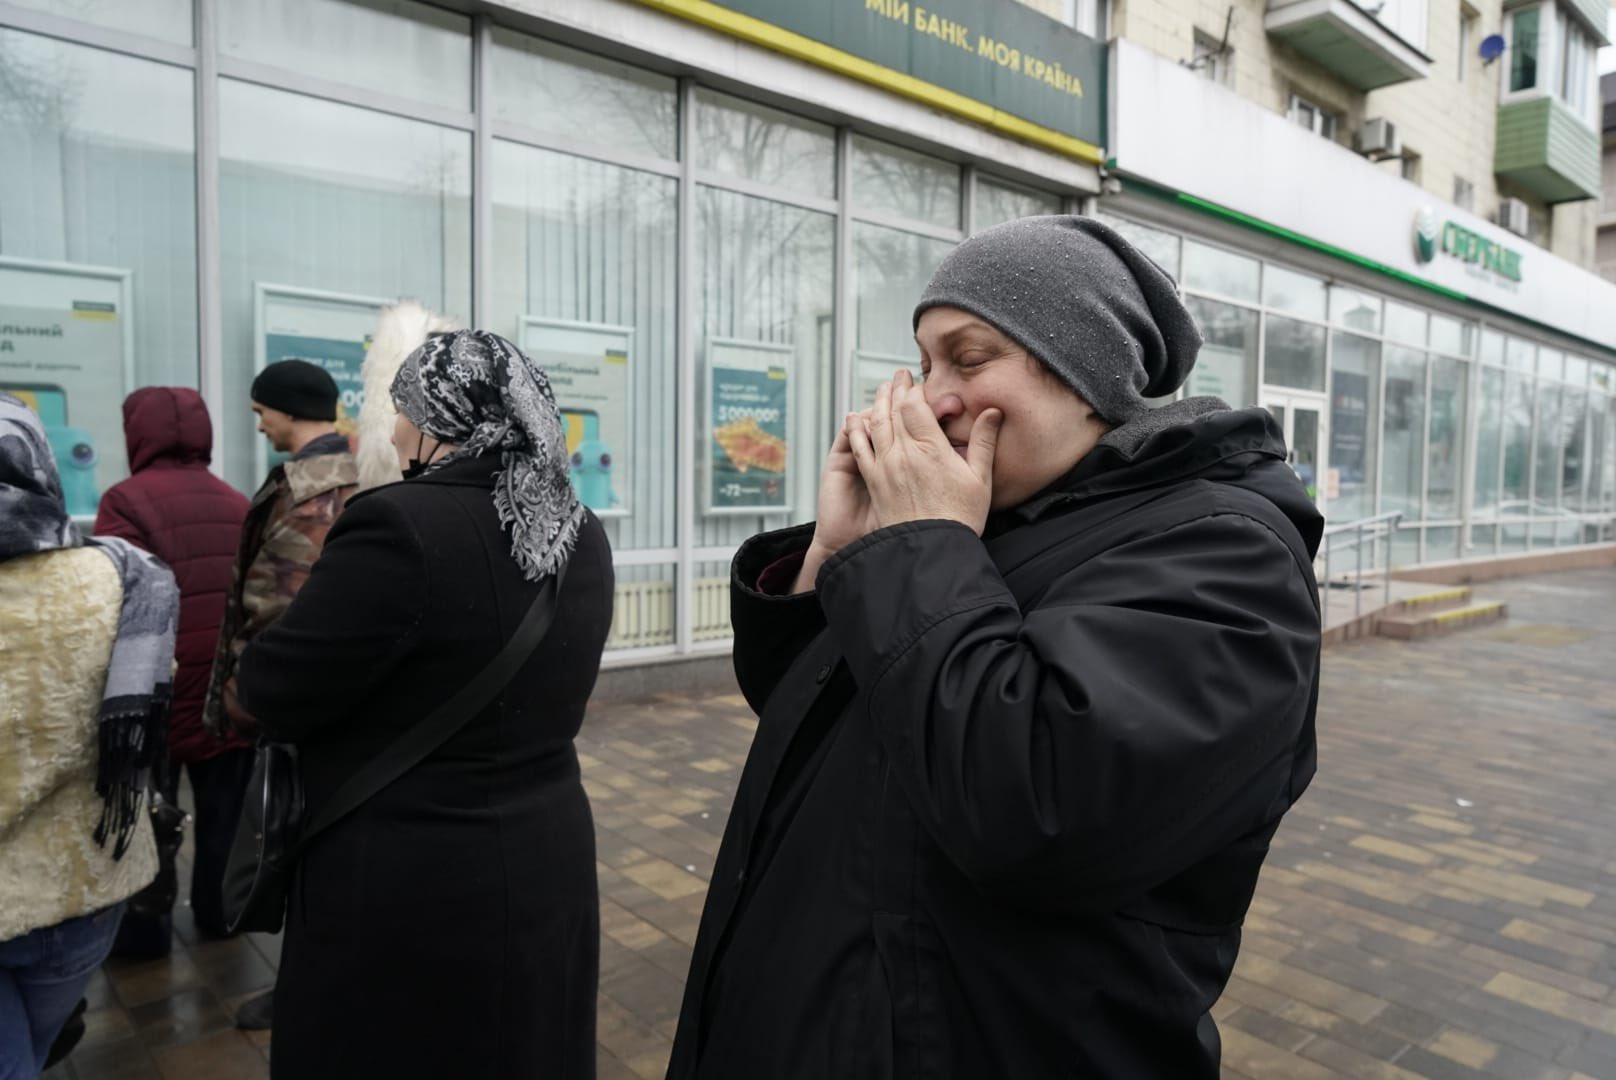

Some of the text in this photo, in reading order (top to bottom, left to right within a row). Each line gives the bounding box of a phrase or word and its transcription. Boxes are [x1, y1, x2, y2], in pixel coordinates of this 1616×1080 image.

[914, 7, 974, 52] БАНК.
[978, 35, 1021, 73] МОЯ
[1024, 55, 1084, 100] КРАЇНА
